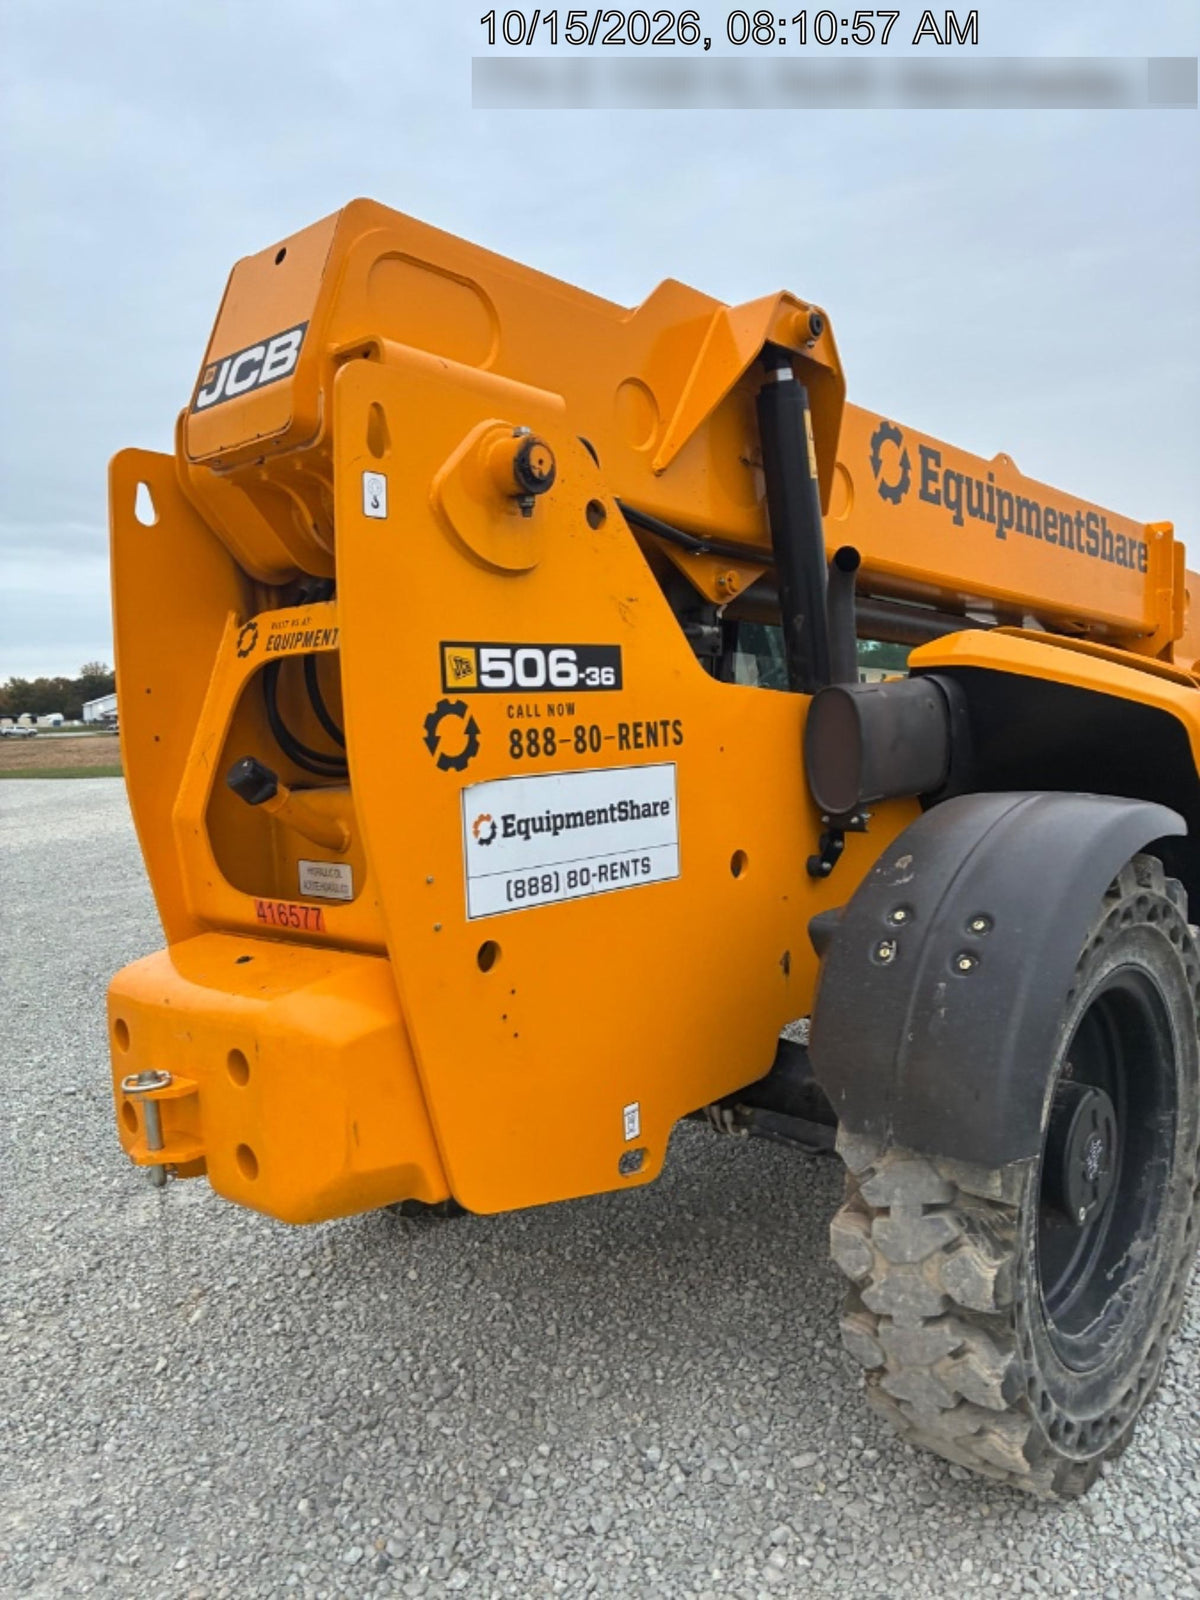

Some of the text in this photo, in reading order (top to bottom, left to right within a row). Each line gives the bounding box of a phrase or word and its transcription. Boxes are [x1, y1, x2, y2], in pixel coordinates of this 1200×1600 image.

[197, 329, 302, 409] JCB
[918, 444, 1148, 573] EquipmentShare
[266, 627, 339, 652] EQUIPMENT
[479, 648, 616, 688] 506-36
[507, 702, 576, 719] CALL NOW
[508, 719, 684, 760] 888-80-RENTS
[501, 799, 671, 842] EquipmentShare
[505, 856, 652, 902] (888) 80-RENTS
[256, 900, 323, 931] 416577
